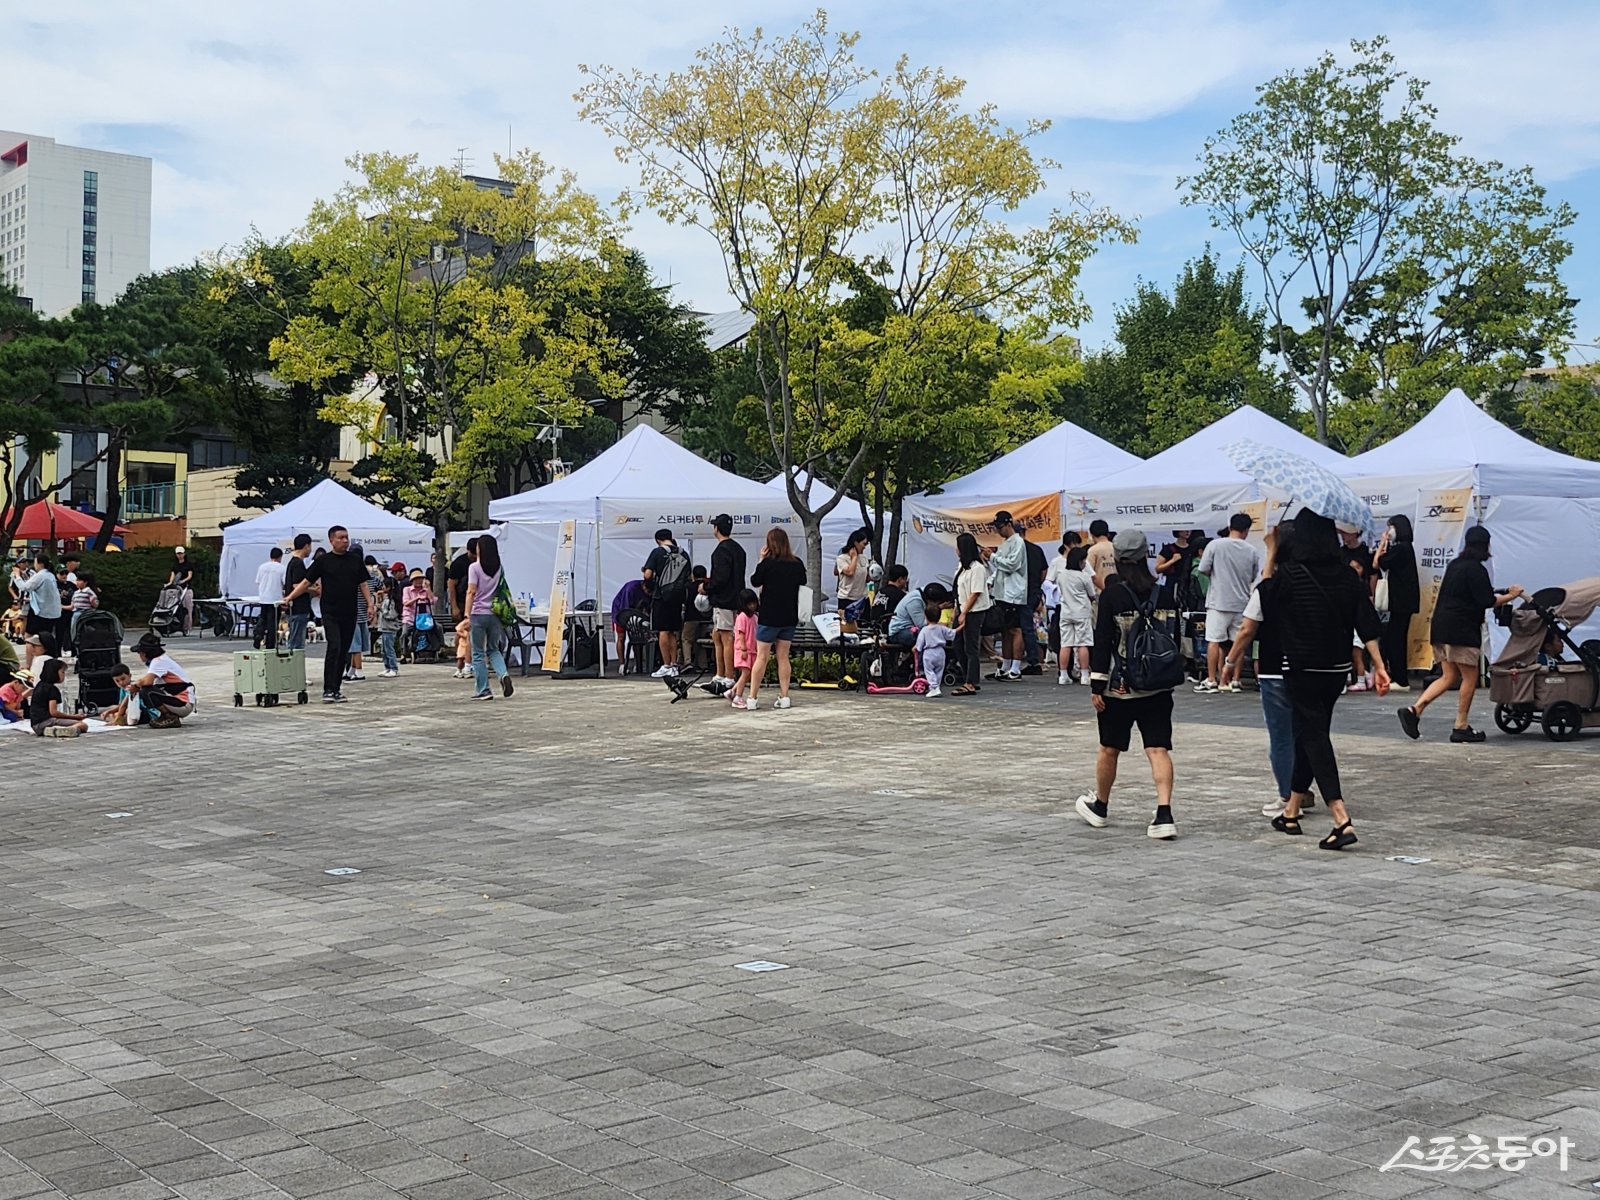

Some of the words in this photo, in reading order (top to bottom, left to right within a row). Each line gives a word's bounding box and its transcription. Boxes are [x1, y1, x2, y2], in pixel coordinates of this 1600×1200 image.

[1116, 504, 1157, 514] STREET
[1160, 503, 1194, 513] 헤어체험
[657, 515, 704, 524] 스티커타투
[1422, 547, 1455, 557] 페이스
